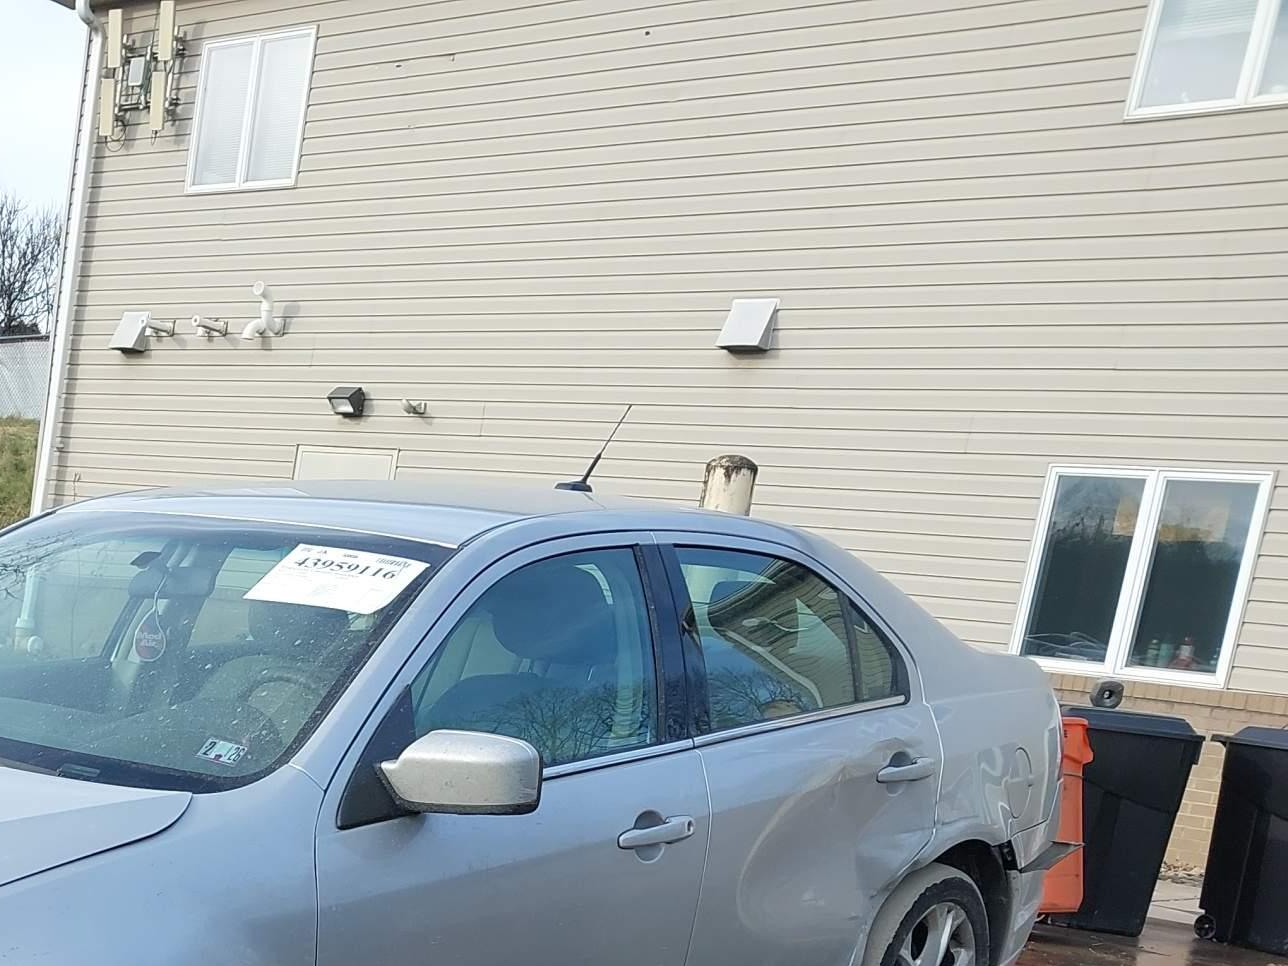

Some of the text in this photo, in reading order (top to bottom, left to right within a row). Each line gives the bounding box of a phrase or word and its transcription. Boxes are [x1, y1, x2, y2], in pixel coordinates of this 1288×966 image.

[294, 556, 397, 580] 43959116
[202, 741, 246, 762] 2 26
